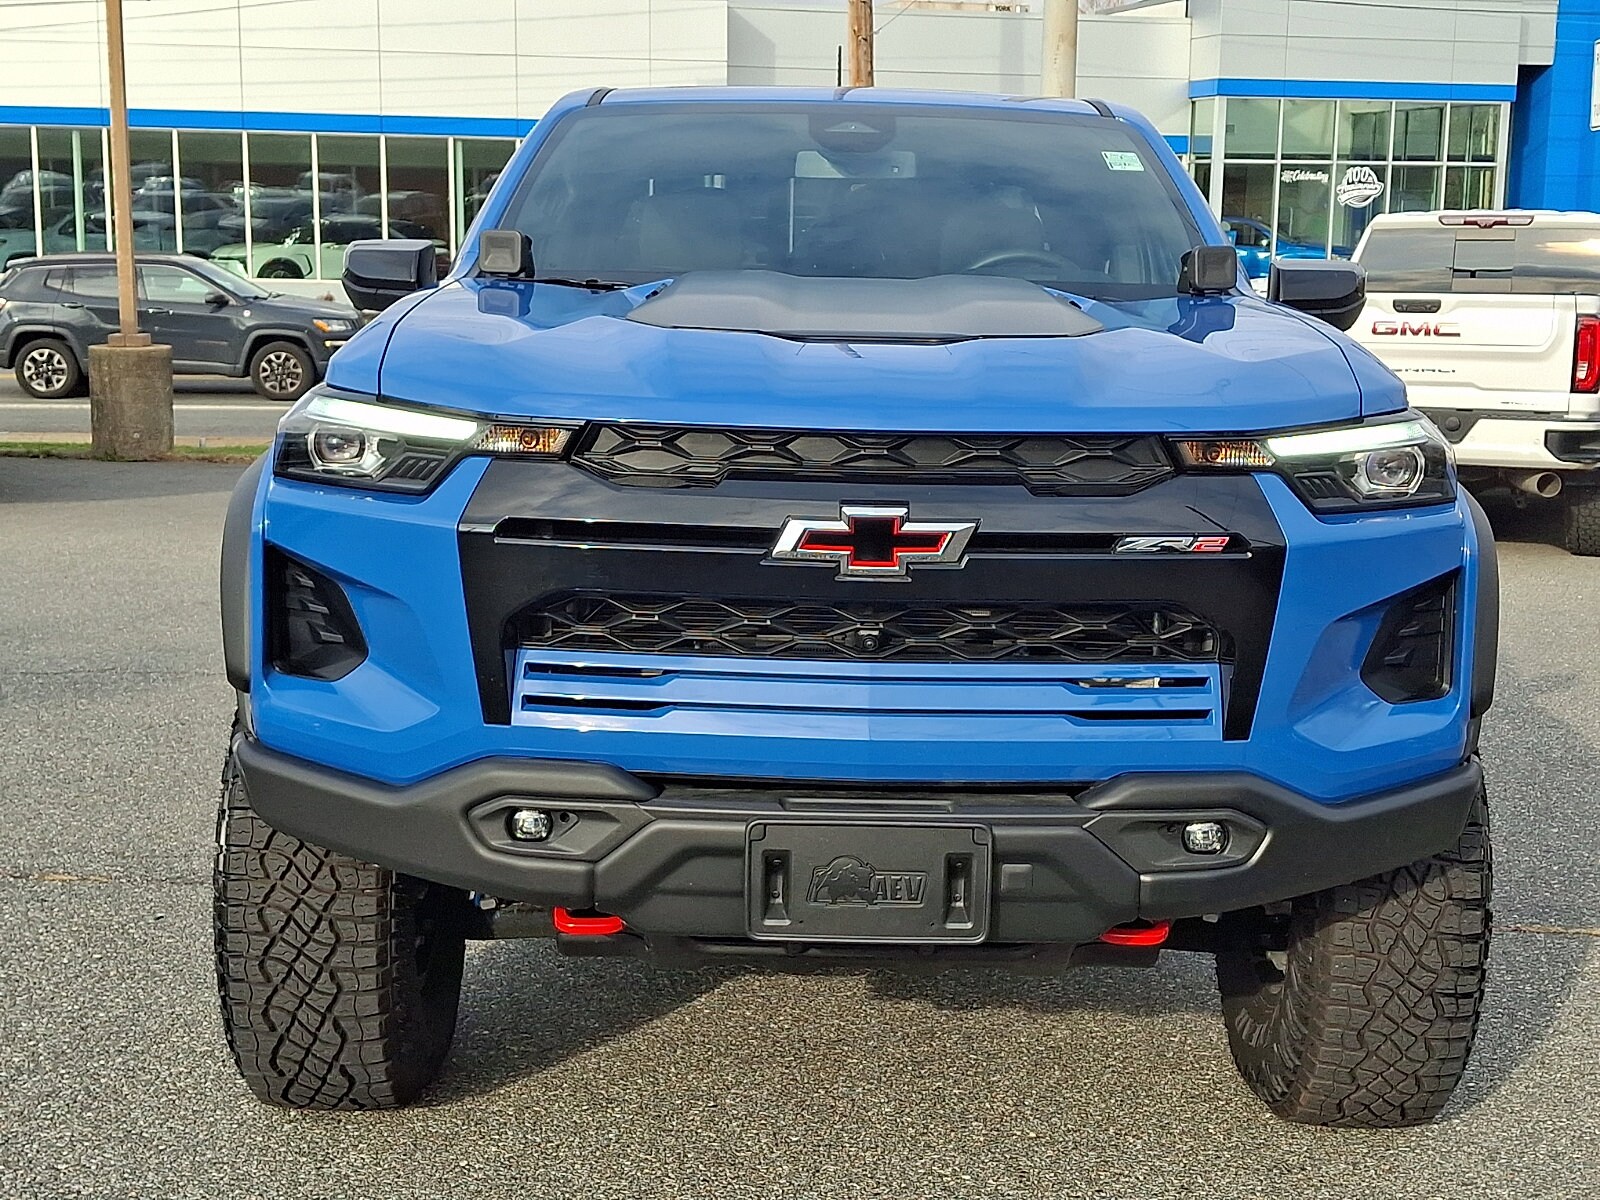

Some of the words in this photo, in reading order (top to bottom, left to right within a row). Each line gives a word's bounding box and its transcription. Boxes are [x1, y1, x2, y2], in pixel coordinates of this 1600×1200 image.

[1346, 166, 1370, 183] 100
[1372, 320, 1461, 337] GMC
[1115, 536, 1230, 553] ZR2
[874, 875, 923, 901] AEV
